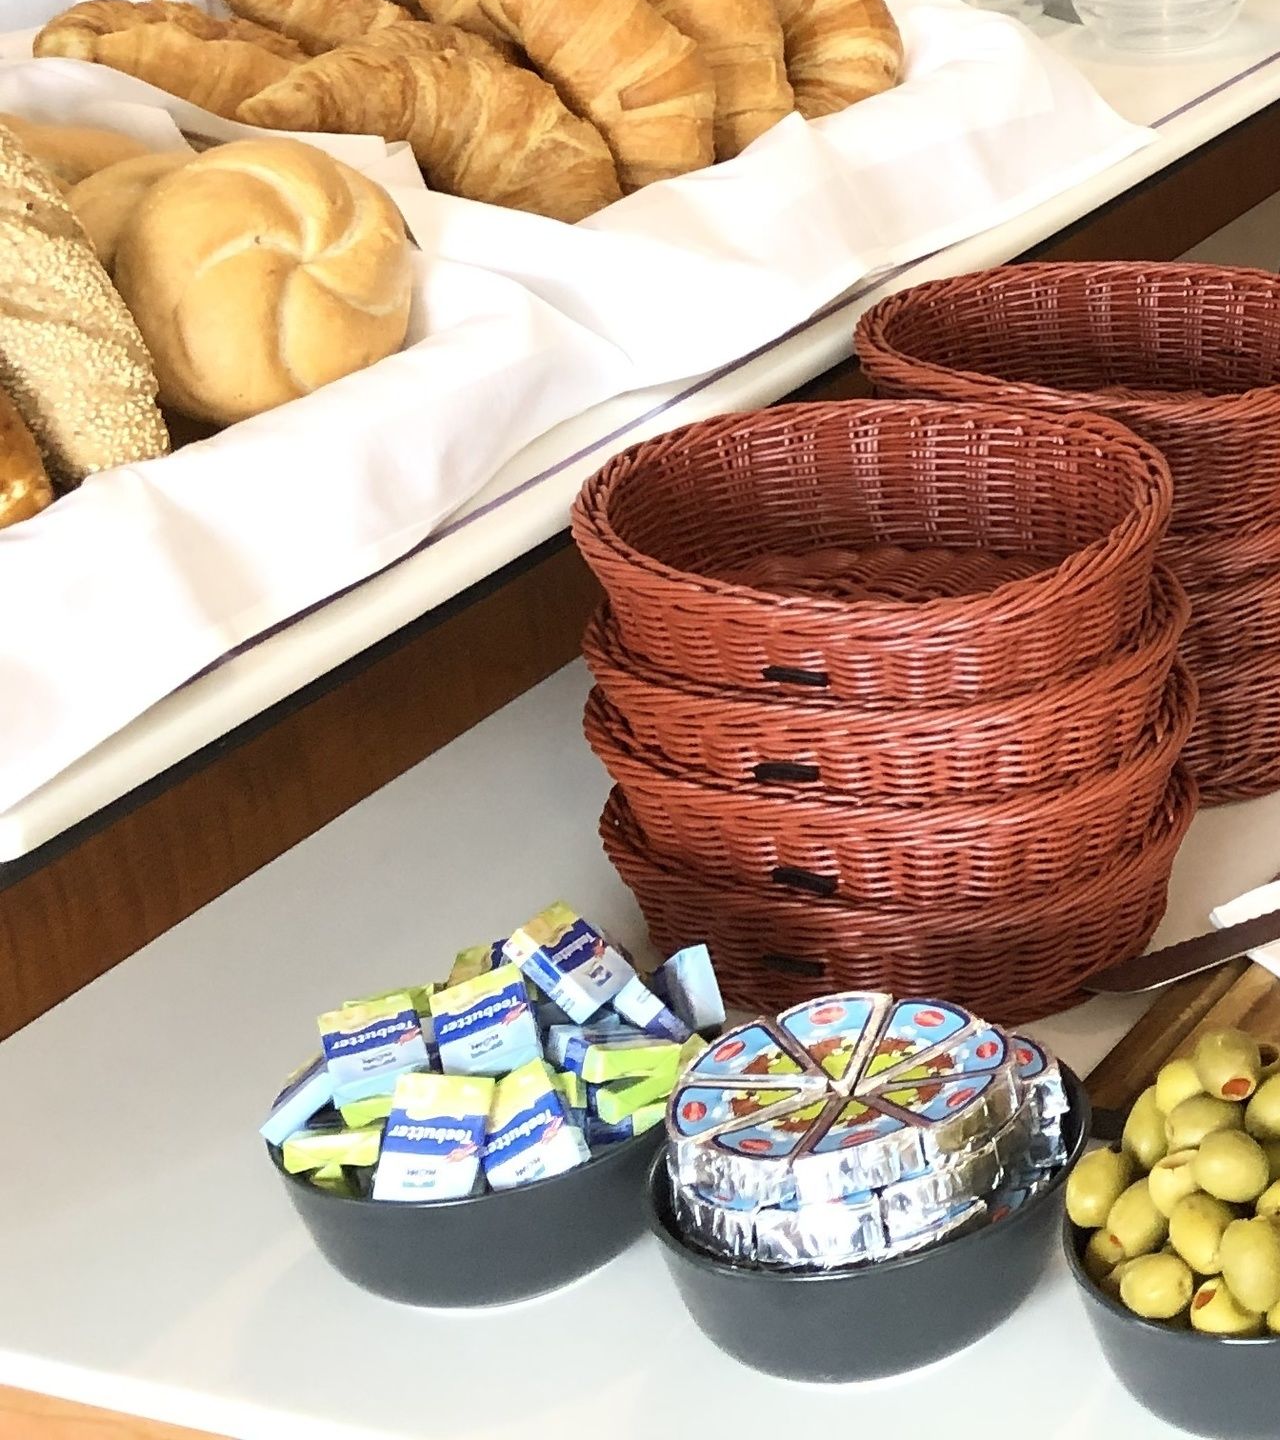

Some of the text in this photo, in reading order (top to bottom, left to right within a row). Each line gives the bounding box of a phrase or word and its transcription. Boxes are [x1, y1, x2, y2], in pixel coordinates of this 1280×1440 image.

[440, 994, 522, 1036] Teebutter
[330, 1019, 415, 1050] Teebutter
[388, 1124, 474, 1145] Teebutter
[487, 1108, 554, 1153] Teebutte
